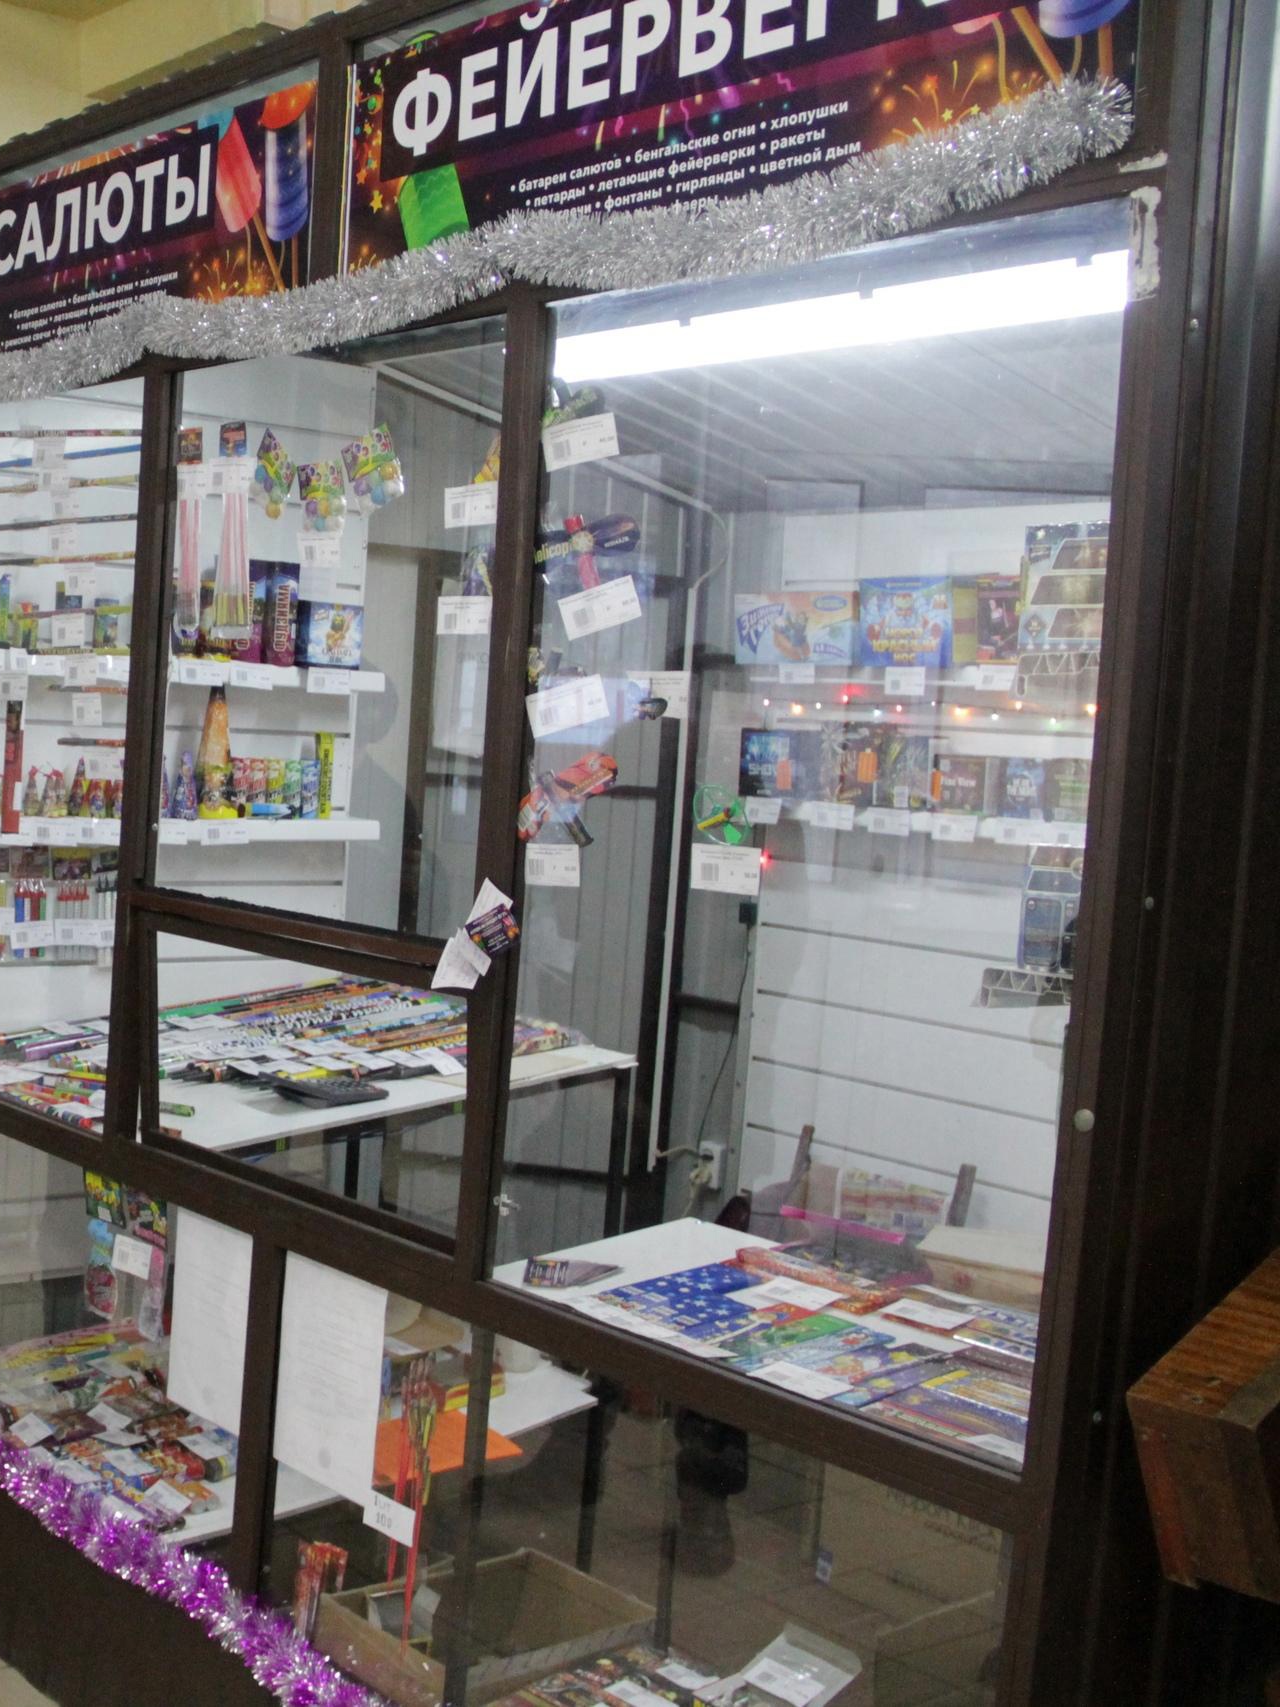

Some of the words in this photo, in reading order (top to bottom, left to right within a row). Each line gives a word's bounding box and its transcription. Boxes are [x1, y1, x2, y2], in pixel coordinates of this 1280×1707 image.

[392, 0, 951, 157] ФЕЙЕРВЕ
[518, 171, 567, 193] батареи
[569, 158, 622, 180] салютов
[634, 133, 719, 163] бенгальские
[722, 124, 756, 142] огни
[770, 101, 848, 130] хлопушки
[533, 185, 586, 207] петарды
[597, 167, 665, 192] летающие
[668, 144, 756, 178] фейерверки
[770, 128, 825, 155] ракеты
[604, 187, 662, 213] фонтаны
[675, 167, 745, 194] гирлянды
[760, 148, 822, 175] цветной
[825, 141, 861, 161] дым
[13, 305, 39, 320] батареи
[39, 299, 67, 314] салютов
[72, 286, 116, 304] бенгальские
[117, 282, 134, 295] огни
[140, 271, 178, 288] хлопушки
[20, 317, 49, 332] петарды
[53, 308, 88, 323] летающие
